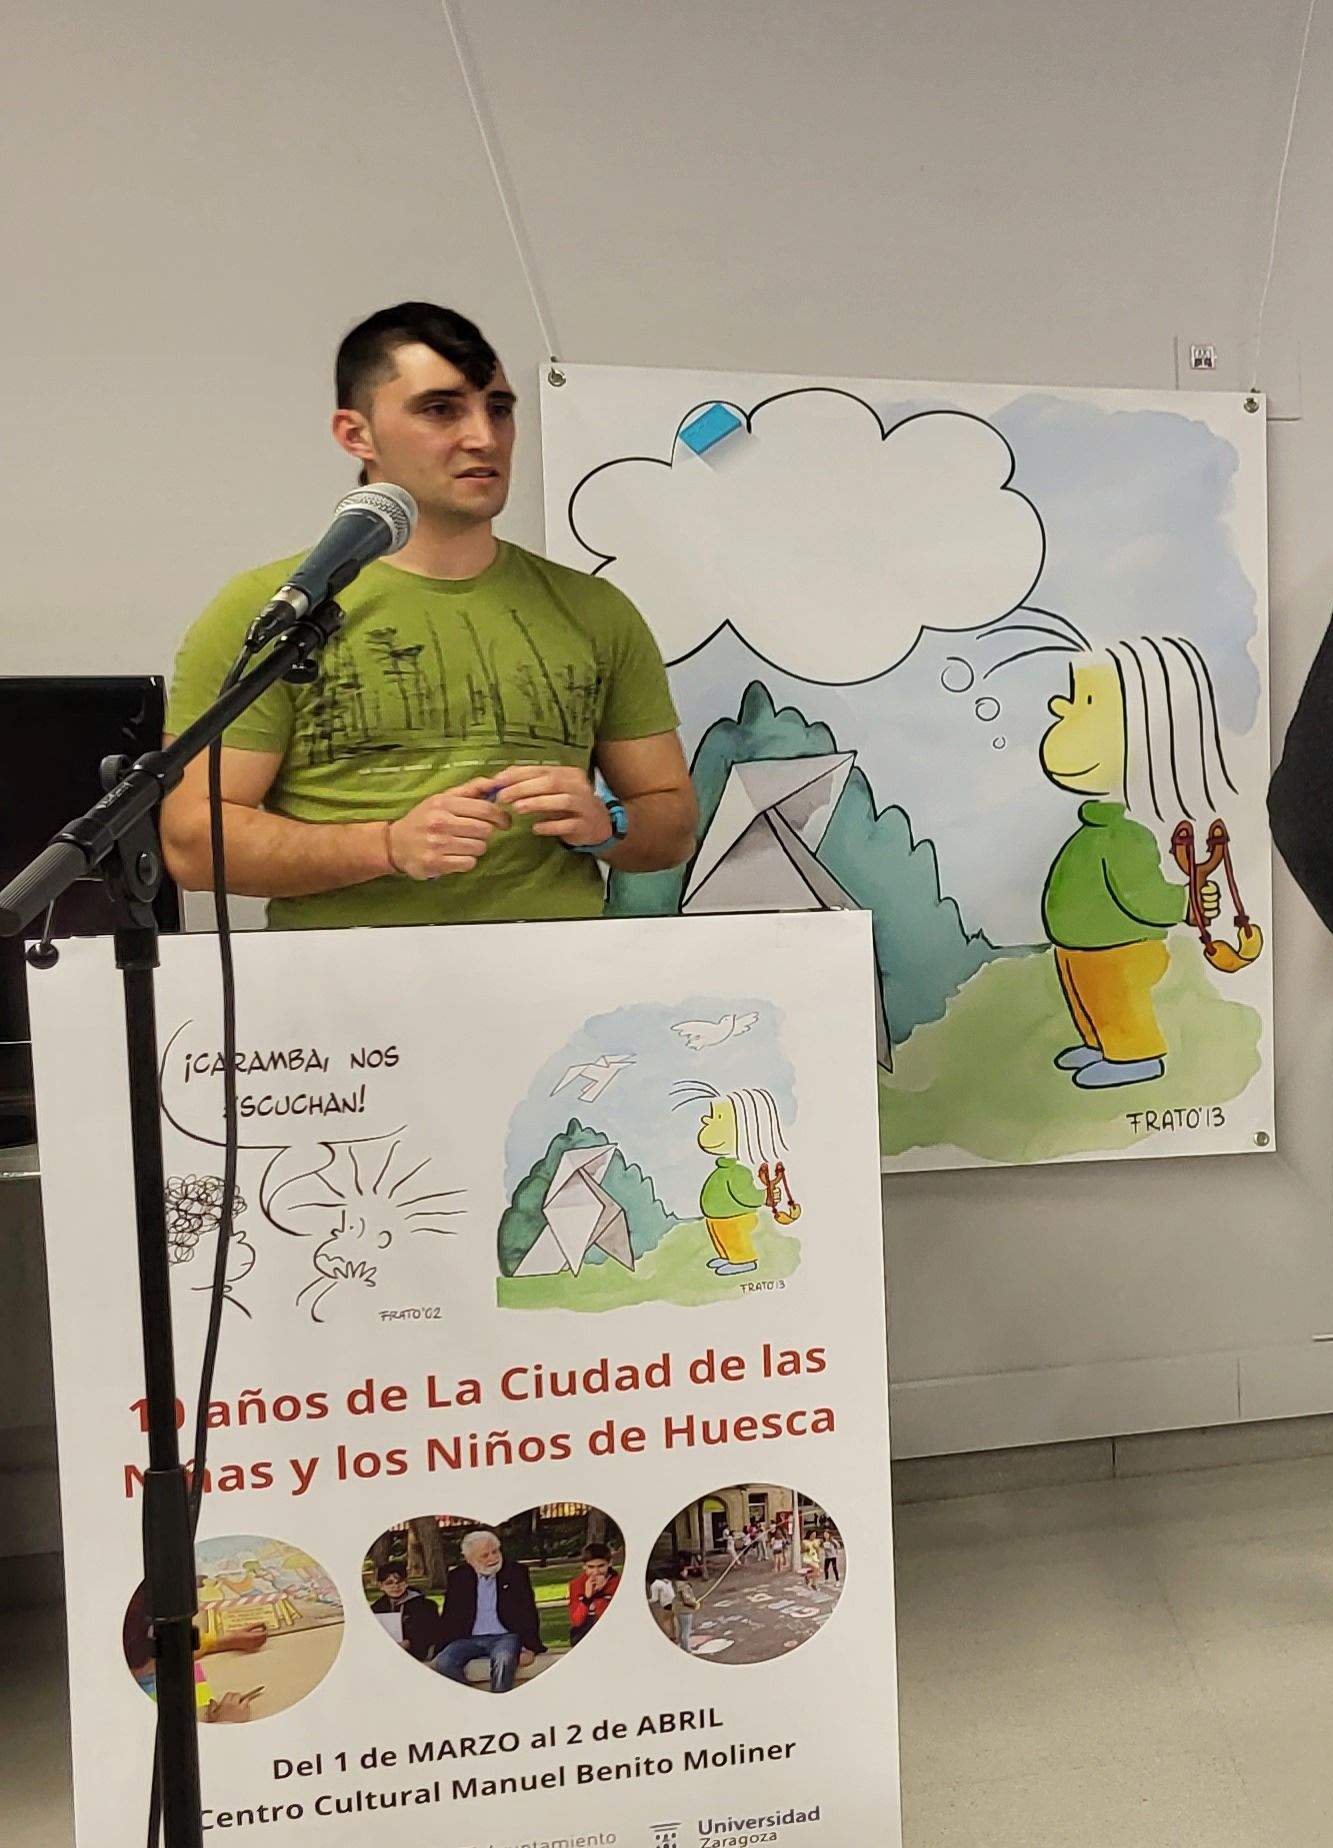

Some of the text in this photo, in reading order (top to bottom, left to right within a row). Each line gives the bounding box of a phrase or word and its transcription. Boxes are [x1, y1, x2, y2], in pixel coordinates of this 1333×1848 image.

[350, 1045, 399, 1069] NOS
[222, 1083, 365, 1119] SCUCHAN!
[205, 1385, 329, 1429] años
[346, 1378, 408, 1416] de
[426, 1375, 482, 1409] La
[500, 1353, 671, 1401] Ciudad
[689, 1348, 746, 1385] de
[762, 1343, 827, 1378] las
[289, 1456, 320, 1496] y
[337, 1444, 408, 1481] los
[426, 1430, 572, 1472] Niños
[588, 1419, 647, 1456] de
[664, 1407, 836, 1449] Huesca
[272, 1707, 724, 1780] Del 1 de MARZO al 2 de ABRIL
[201, 1740, 797, 1830] Centro Cultural Manuel Benito Moliner
[698, 1805, 821, 1836] Universidad
[699, 1831, 778, 1848] Zaragoza
